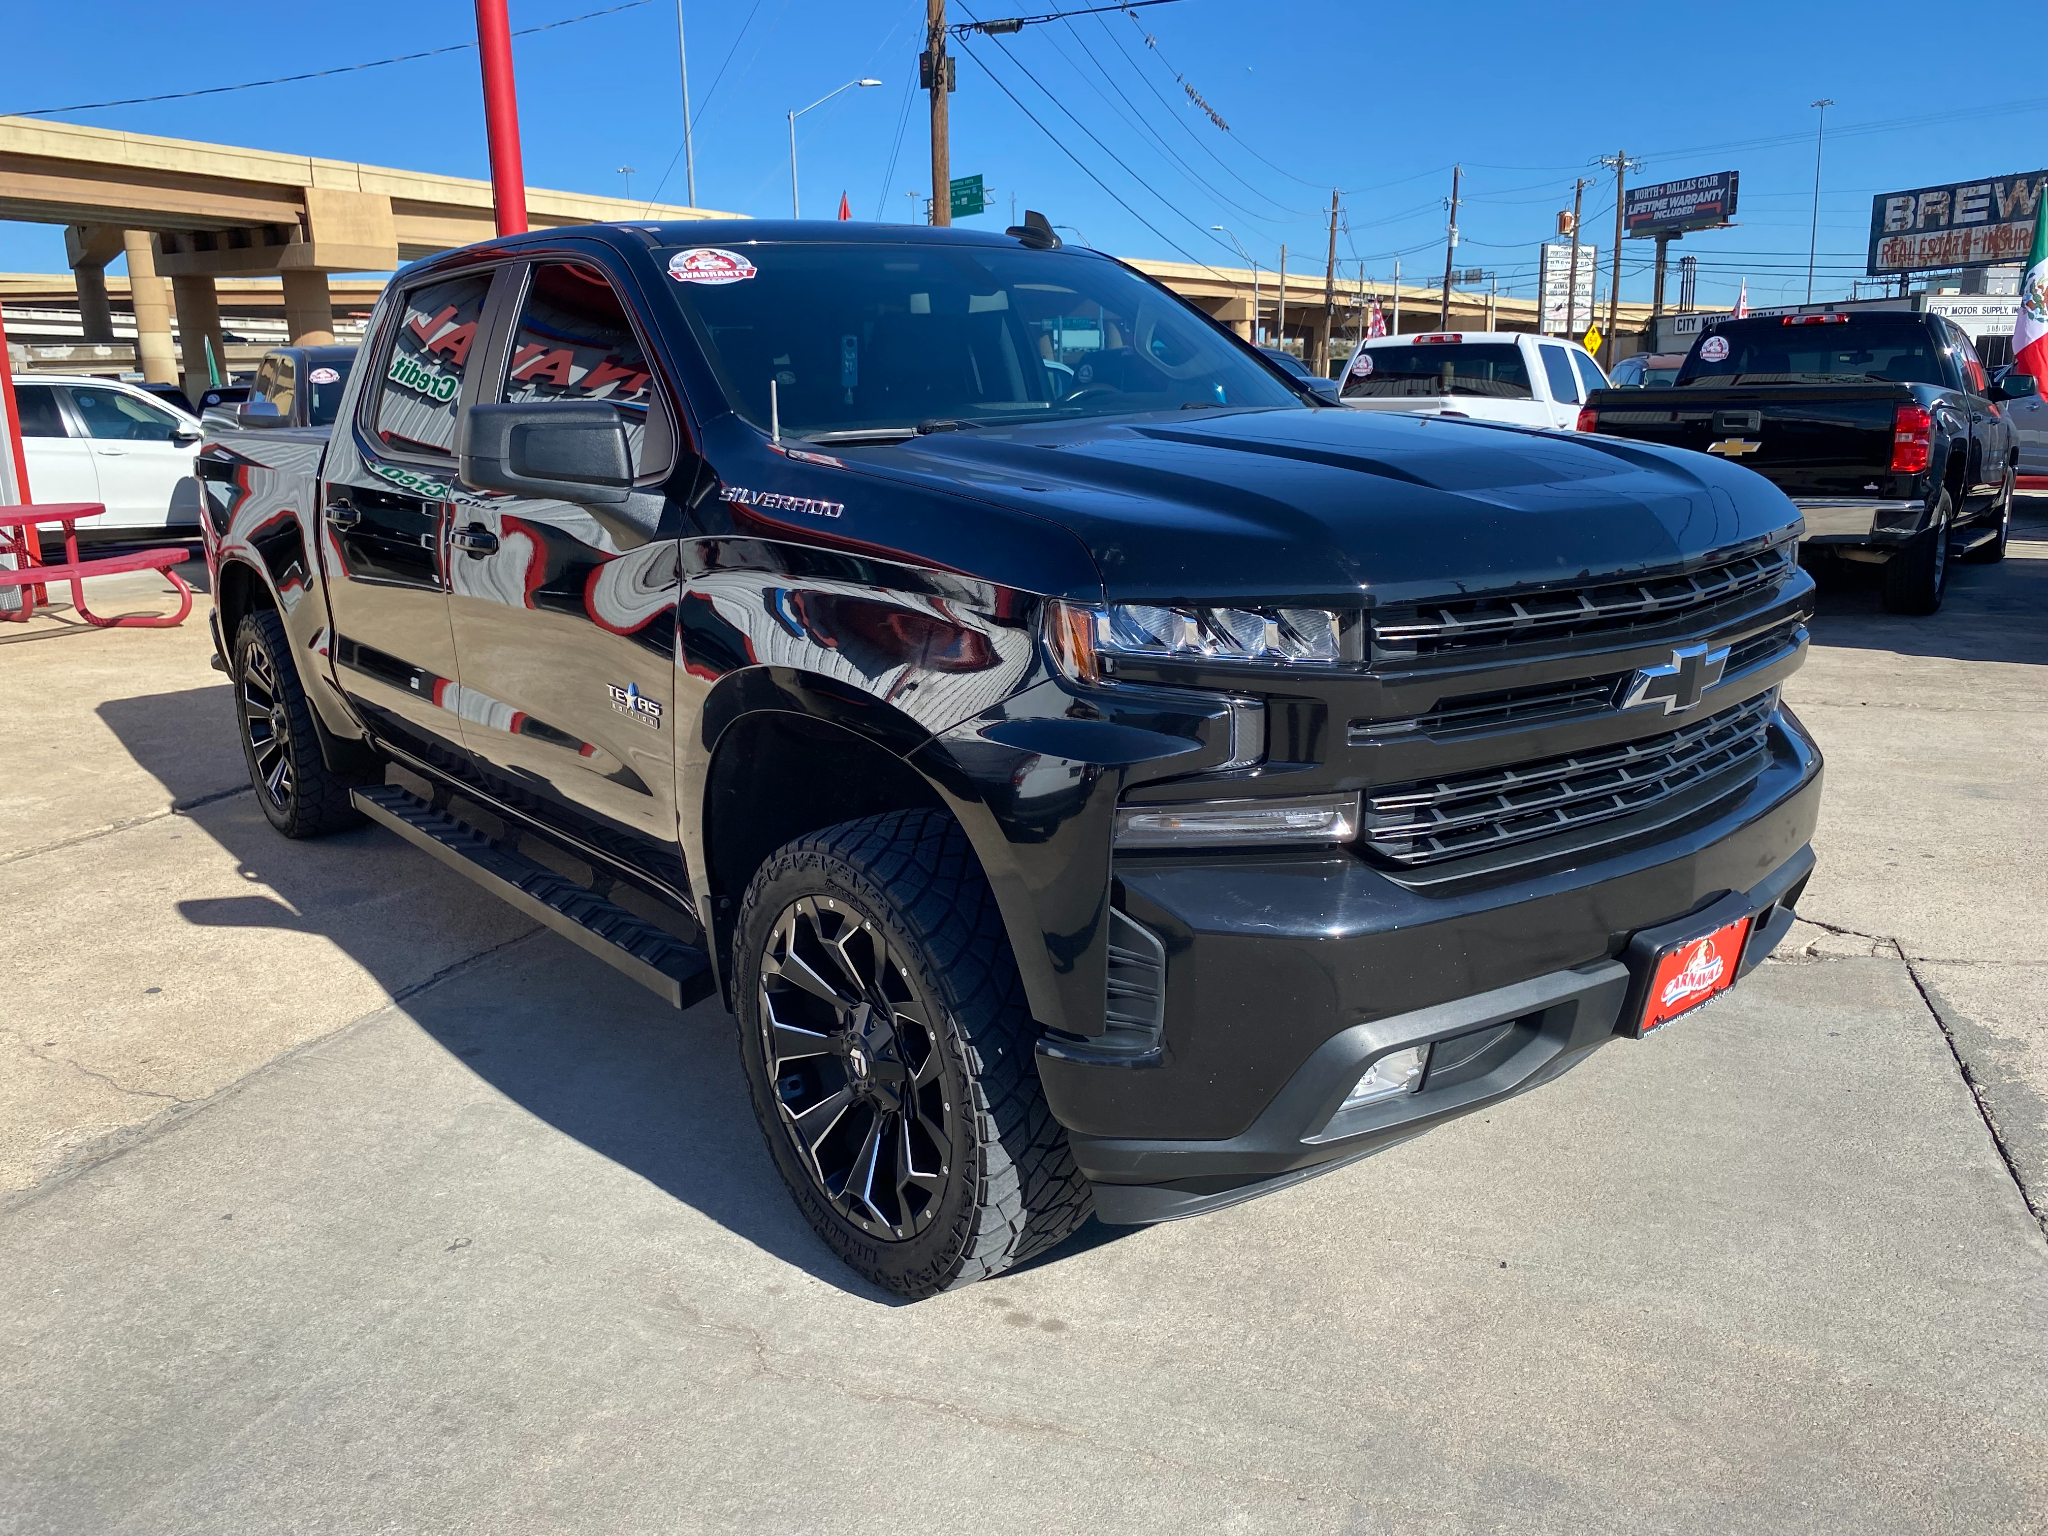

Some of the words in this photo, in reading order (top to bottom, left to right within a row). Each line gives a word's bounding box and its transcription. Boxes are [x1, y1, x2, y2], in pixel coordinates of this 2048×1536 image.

[1634, 187, 1659, 201] NORTH
[1666, 179, 1696, 194] DALLAS
[1697, 174, 1719, 189] CDJR
[1627, 197, 1669, 216] LIFETIME
[1669, 187, 1726, 208] WARRANTY
[1653, 205, 1696, 220] INCLUDED!
[1881, 238, 1914, 264] REAL
[678, 269, 748, 279] WARRANTY
[1931, 306, 1949, 316] CITY
[1952, 306, 1978, 315] MOTOR
[1677, 317, 1697, 332] CITY
[718, 486, 845, 519] SILVERADO
[606, 682, 663, 717] TEXAS
[611, 702, 656, 726] EDITION
[1661, 960, 1724, 1003] CARNAVAL
